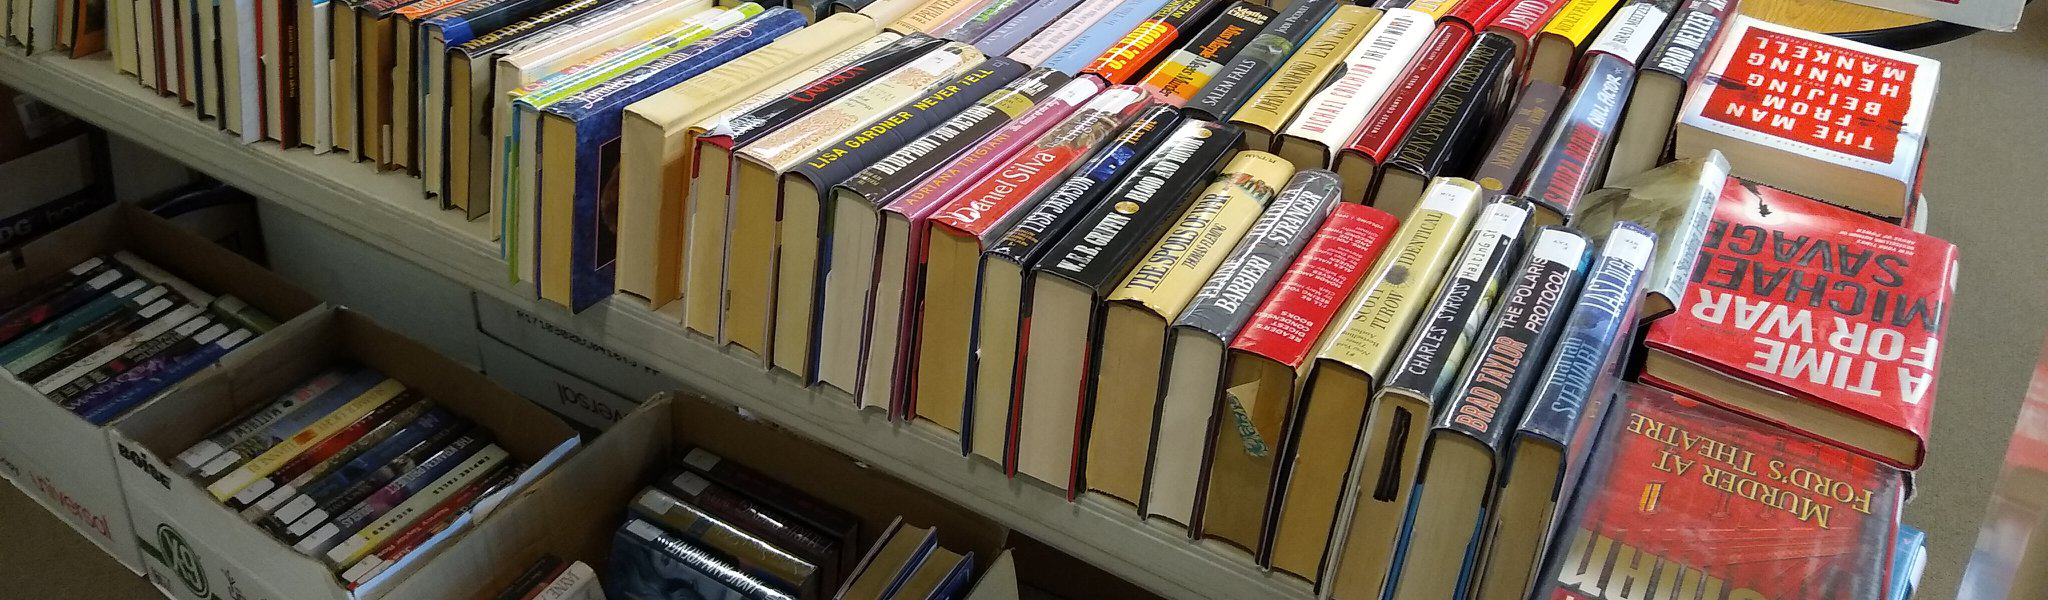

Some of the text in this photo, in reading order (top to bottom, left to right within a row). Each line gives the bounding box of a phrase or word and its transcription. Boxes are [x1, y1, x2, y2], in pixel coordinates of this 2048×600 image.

[1174, 8, 1185, 18] IN
[1227, 9, 1265, 26] Christie
[1236, 6, 1269, 21] Agatha
[1500, 0, 1549, 30] DAVID
[1613, 3, 1652, 45] BRAD MELTZER
[1672, 10, 1717, 51] MELTZER
[466, 20, 531, 50] Martha
[1126, 20, 1169, 52] ROBB
[1200, 25, 1246, 58] Miss Marple
[1203, 5, 1310, 106] SALEM FALLS JODI PICOULT
[1159, 57, 1213, 97] Meets Murder
[1301, 15, 1413, 134] MICHAEL CRICHTON THE LOST WORLD
[1658, 46, 1695, 75] BRAD
[1747, 52, 1900, 98] HENNING
[1757, 36, 1906, 81] MANKELL
[1252, 91, 1279, 115] JOHN
[1271, 61, 1317, 96] SANDFORD
[1406, 75, 1421, 90] WORLD
[1599, 74, 1623, 106] FACTOR
[1747, 73, 1882, 116] BEIJING
[807, 146, 848, 169] LISA
[846, 111, 912, 149] GARDNER
[914, 82, 958, 112] NEVER
[959, 67, 994, 86] TELL
[1062, 111, 1101, 142] English
[1400, 138, 1431, 168] JOHN
[1417, 93, 1463, 141] SANDFORD
[1726, 102, 1796, 131] MAN
[1762, 94, 1852, 127] FROM
[880, 104, 996, 176] BLUEPRINT FOR ACTION
[1812, 125, 1875, 151] THE
[906, 167, 959, 206] ADRIANA
[958, 132, 1007, 169] TRIGIANI
[951, 151, 1055, 225] Daniel Silva
[1124, 135, 1206, 204] BLOOD AND HONOR
[1019, 175, 1096, 233] LISA JACKSON
[1267, 189, 1324, 247] STRANGER
[1083, 211, 1132, 247] GRIFFIN
[1125, 192, 1232, 291] THE SPOILS OF WAR
[1181, 223, 1228, 270] THOMAS FLEMING
[1404, 213, 1443, 267] IDENTICAL
[1702, 218, 1909, 287] SAVAGE
[1201, 252, 1245, 299] ELAINE
[1213, 254, 1273, 315] BARBIERI
[1283, 285, 1331, 305] SEEING YOU
[1312, 269, 1344, 285] THIEVES
[1314, 276, 1342, 289] HONOR
[1499, 256, 1549, 330] THE POLARIS
[1692, 248, 1944, 332] MICHAEL
[1255, 310, 1310, 332] CONDENSED
[1280, 310, 1314, 327] BOOKS
[1353, 288, 1383, 323] SCOTT
[1371, 291, 1405, 332] TUROW
[1525, 269, 1569, 333] PROTOCOL
[1255, 322, 1303, 344] READER'S
[1271, 320, 1307, 338] DIGEST
[1409, 280, 1472, 376] CHARLES STROSS
[1691, 288, 1938, 371] FOR WAR
[1456, 335, 1529, 433] BRAD TAYLOR
[1551, 342, 1604, 419] STEWART
[1747, 336, 1935, 405] A TIME
[431, 472, 459, 496] FALLS
[460, 454, 491, 476] EMPIRE
[1627, 412, 1875, 516] FORD'S THEATRE
[1651, 449, 1833, 529] MURDER AT
[371, 507, 415, 538] RICHARD
